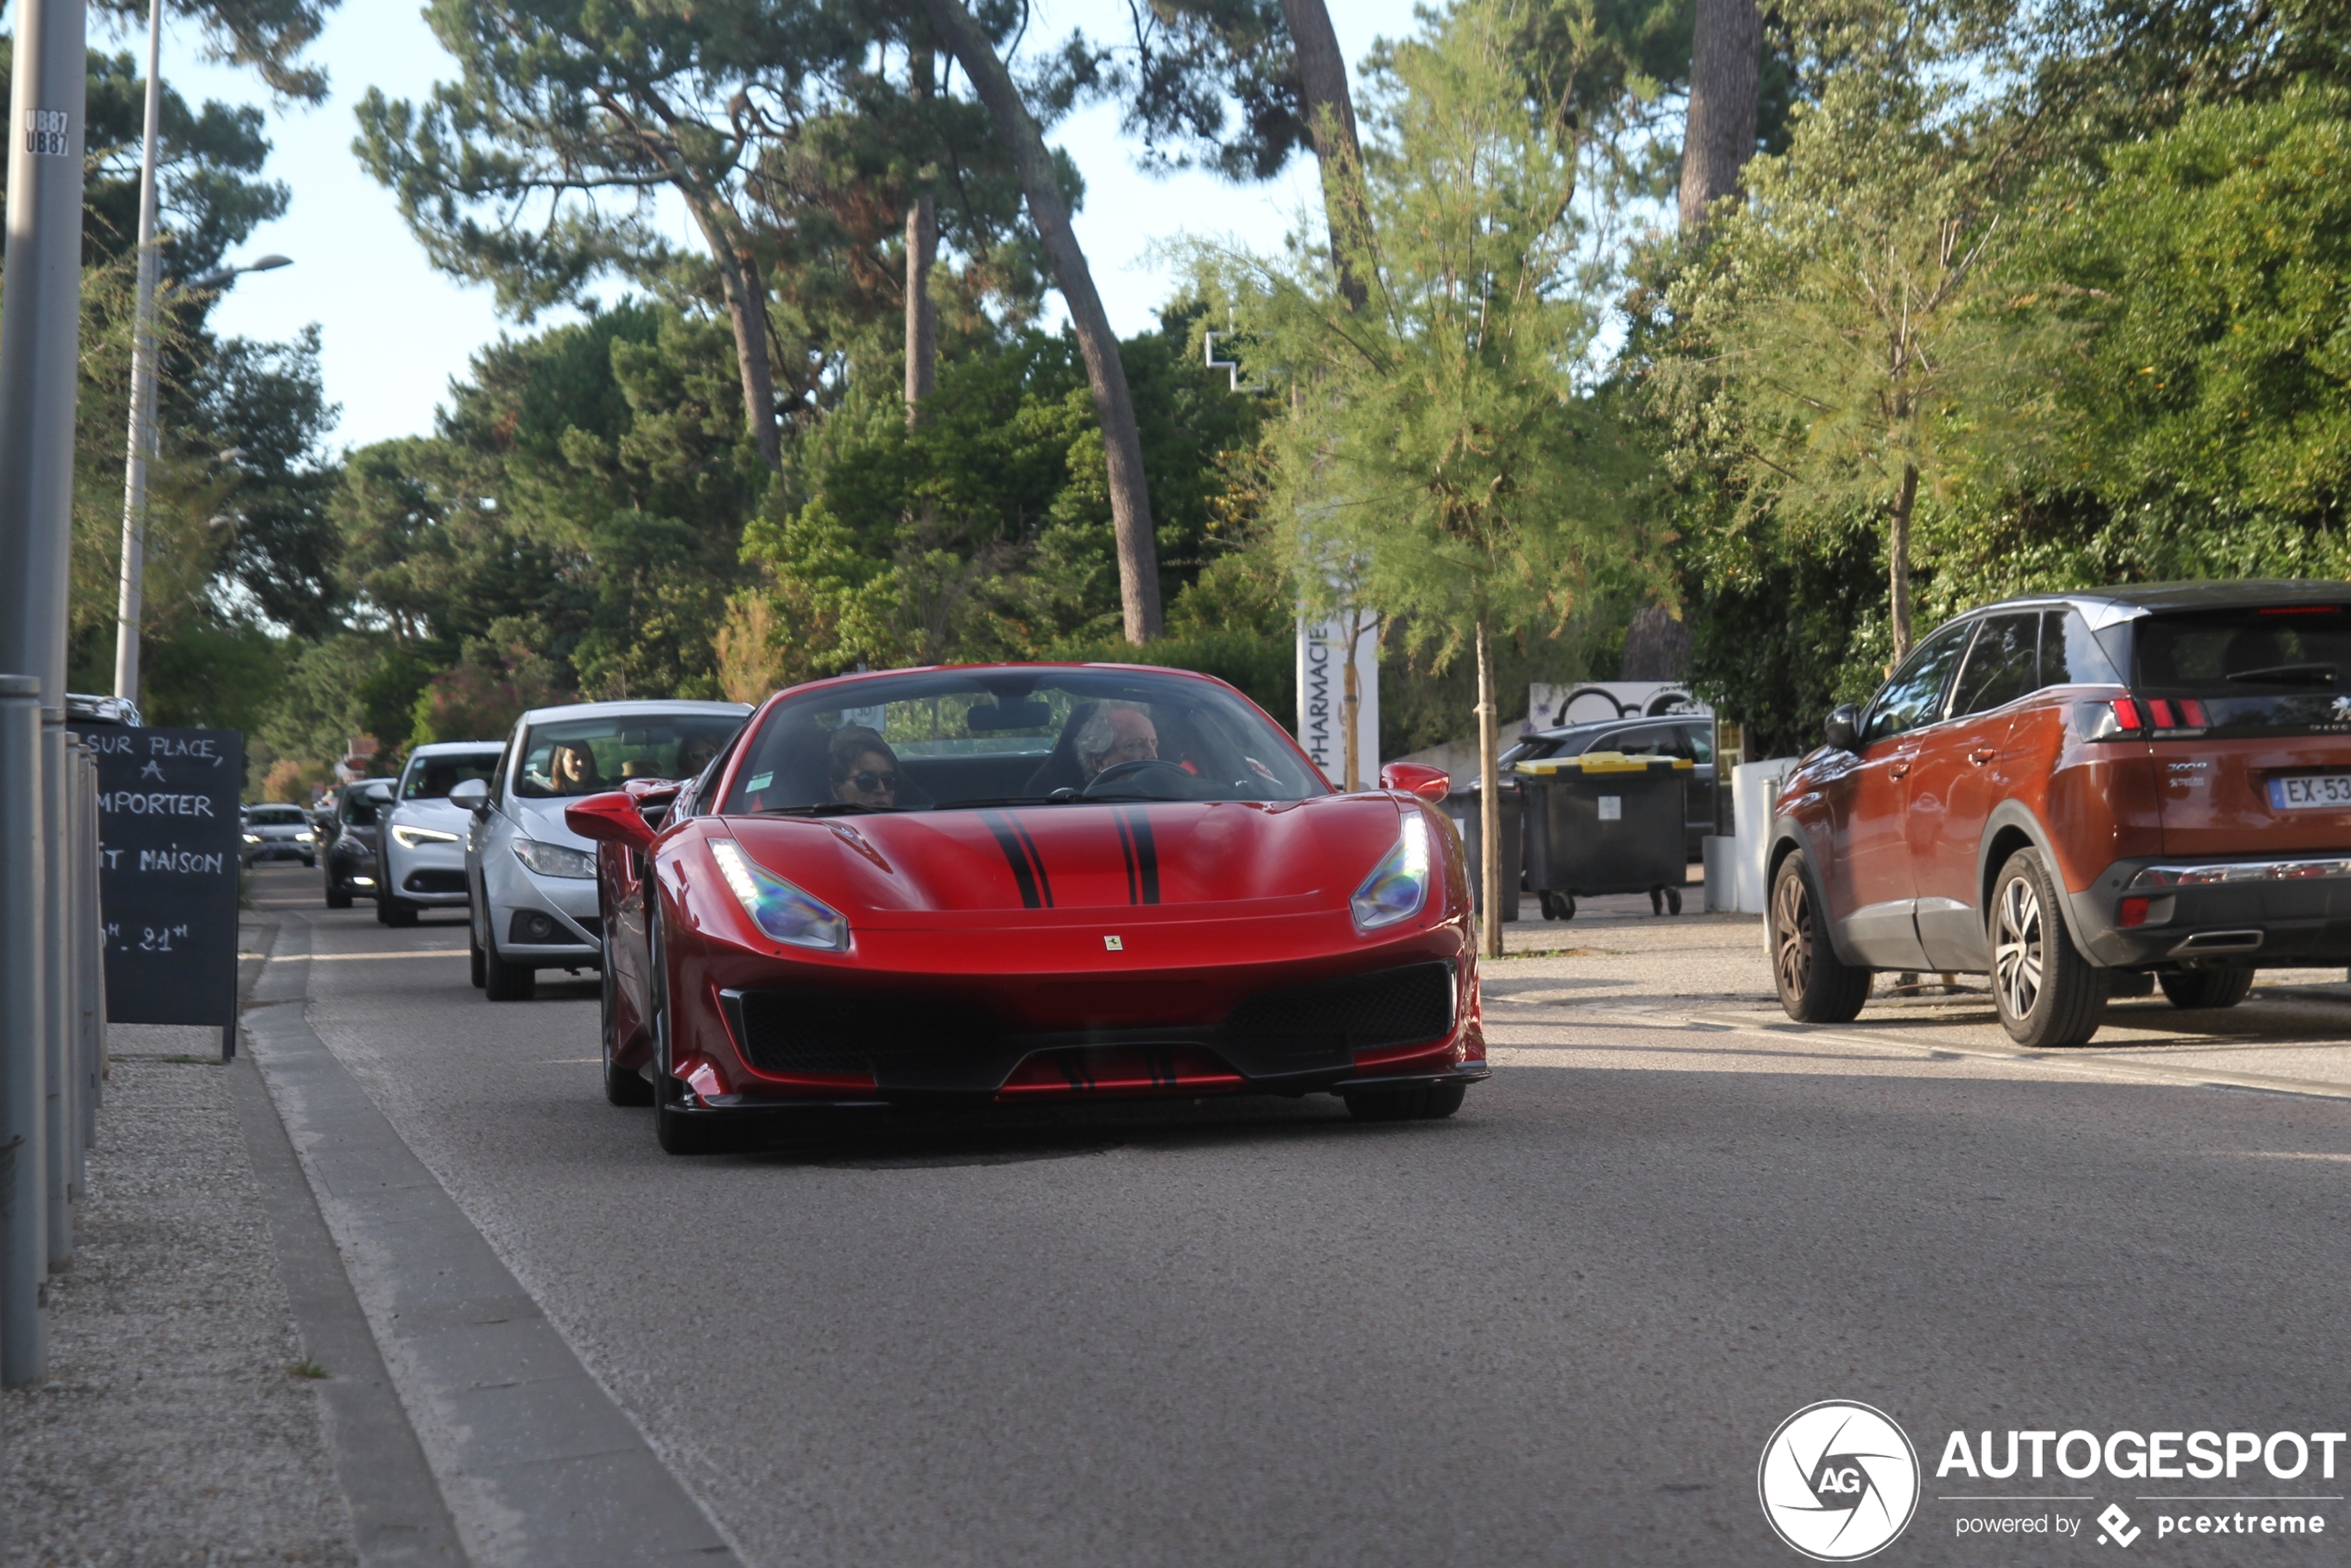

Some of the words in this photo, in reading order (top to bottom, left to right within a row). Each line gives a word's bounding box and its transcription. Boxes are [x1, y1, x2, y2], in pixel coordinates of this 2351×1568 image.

[26, 109, 68, 132] UB87
[26, 131, 67, 155] UB87
[1309, 627, 1330, 767] PHARMACIE
[2309, 722, 2351, 731] PEUG
[86, 734, 134, 754] SUR
[149, 737, 223, 767] PLACE,
[140, 759, 166, 782] A
